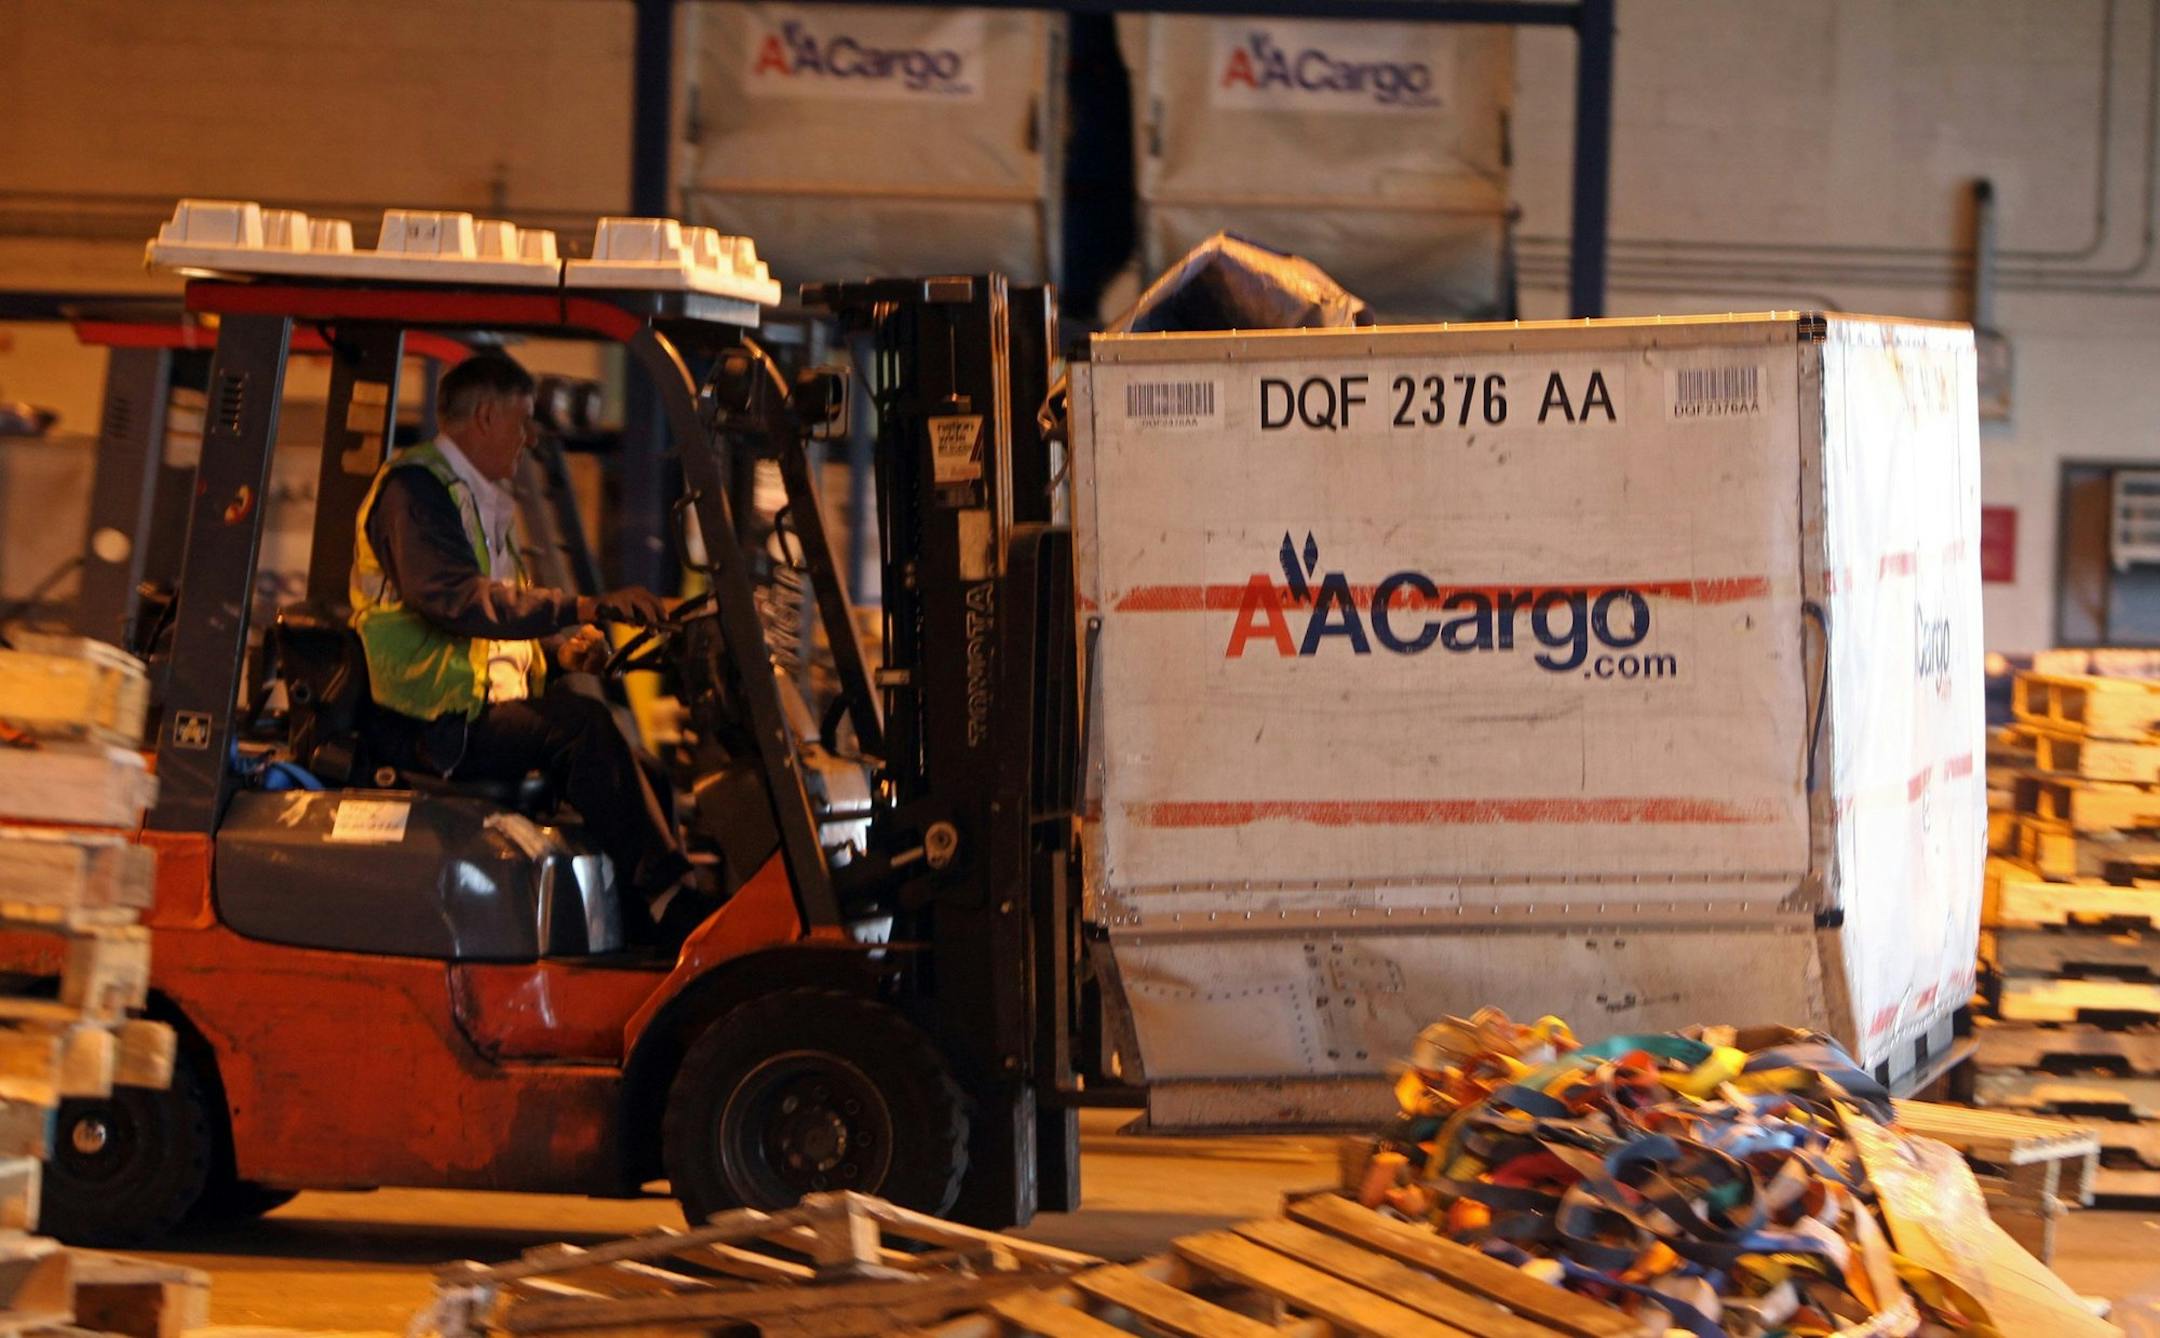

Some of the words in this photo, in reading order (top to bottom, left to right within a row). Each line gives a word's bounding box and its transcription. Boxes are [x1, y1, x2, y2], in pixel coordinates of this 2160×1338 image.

[1260, 374, 1369, 432] DQF
[1392, 373, 1508, 427] 2376
[1537, 369, 1617, 426] AA
[1584, 652, 1678, 680] .com
